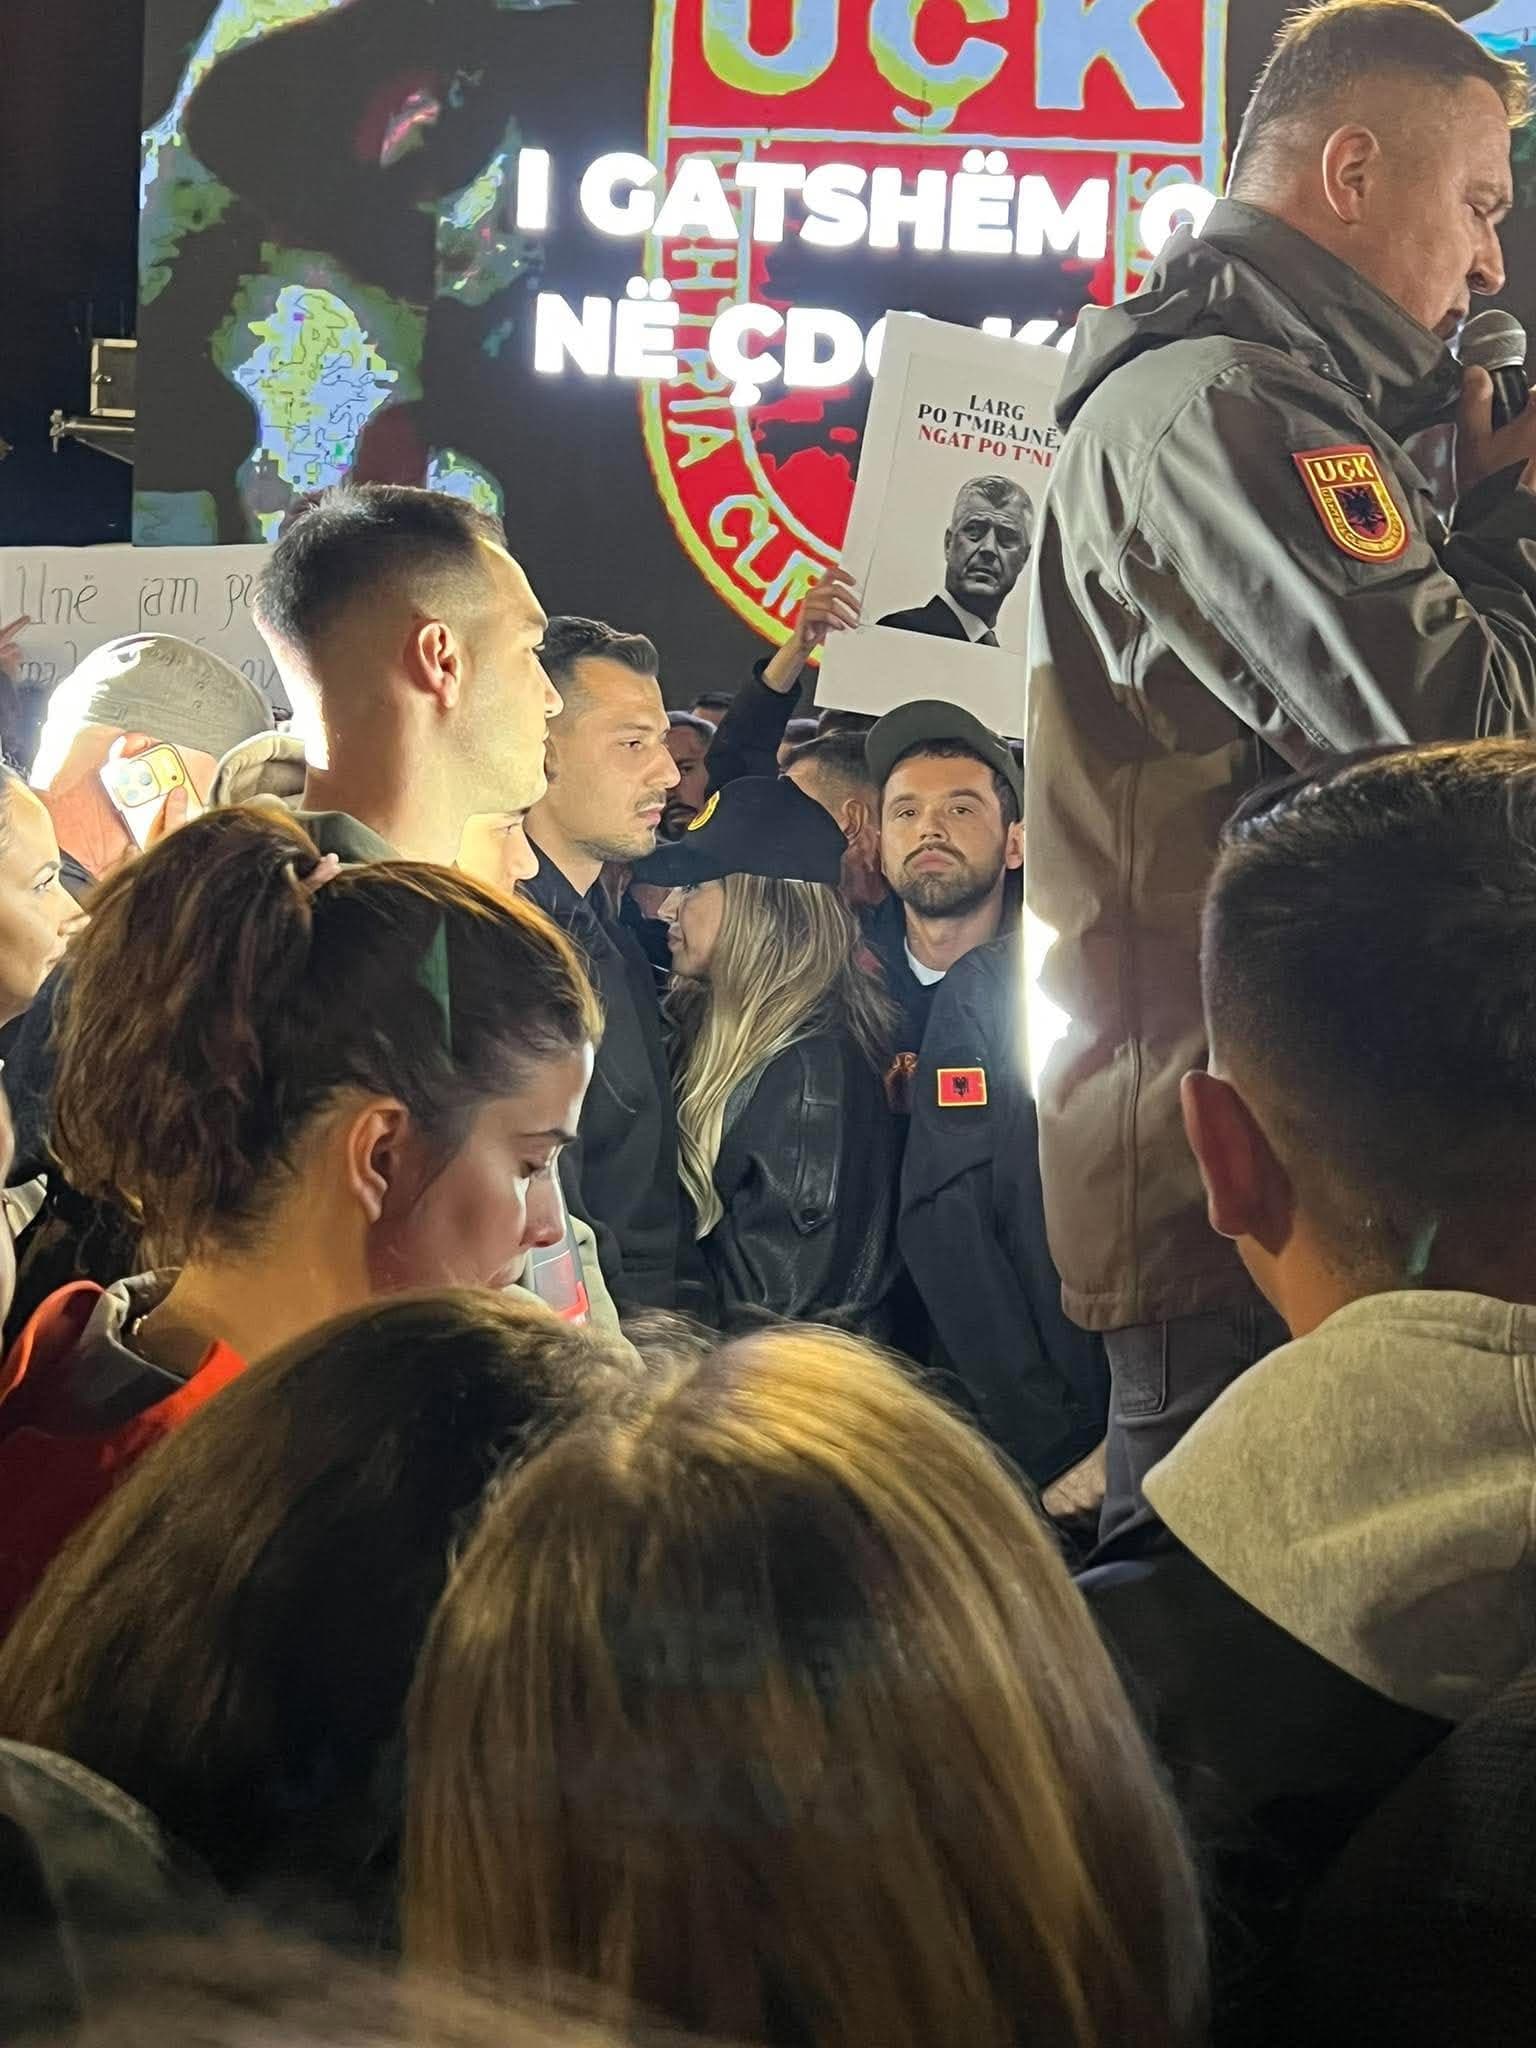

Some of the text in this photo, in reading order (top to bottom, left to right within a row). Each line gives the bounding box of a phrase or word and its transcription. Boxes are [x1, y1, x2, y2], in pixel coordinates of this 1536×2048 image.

[516, 148, 549, 230] I
[580, 149, 1110, 260] GATSHËM
[533, 277, 680, 380] NË
[918, 403, 947, 424] PO
[969, 394, 1025, 421] LARG
[919, 424, 974, 450] NGAT
[978, 437, 1007, 457] PO
[17, 560, 98, 625] Unë
[138, 575, 199, 632] jam
